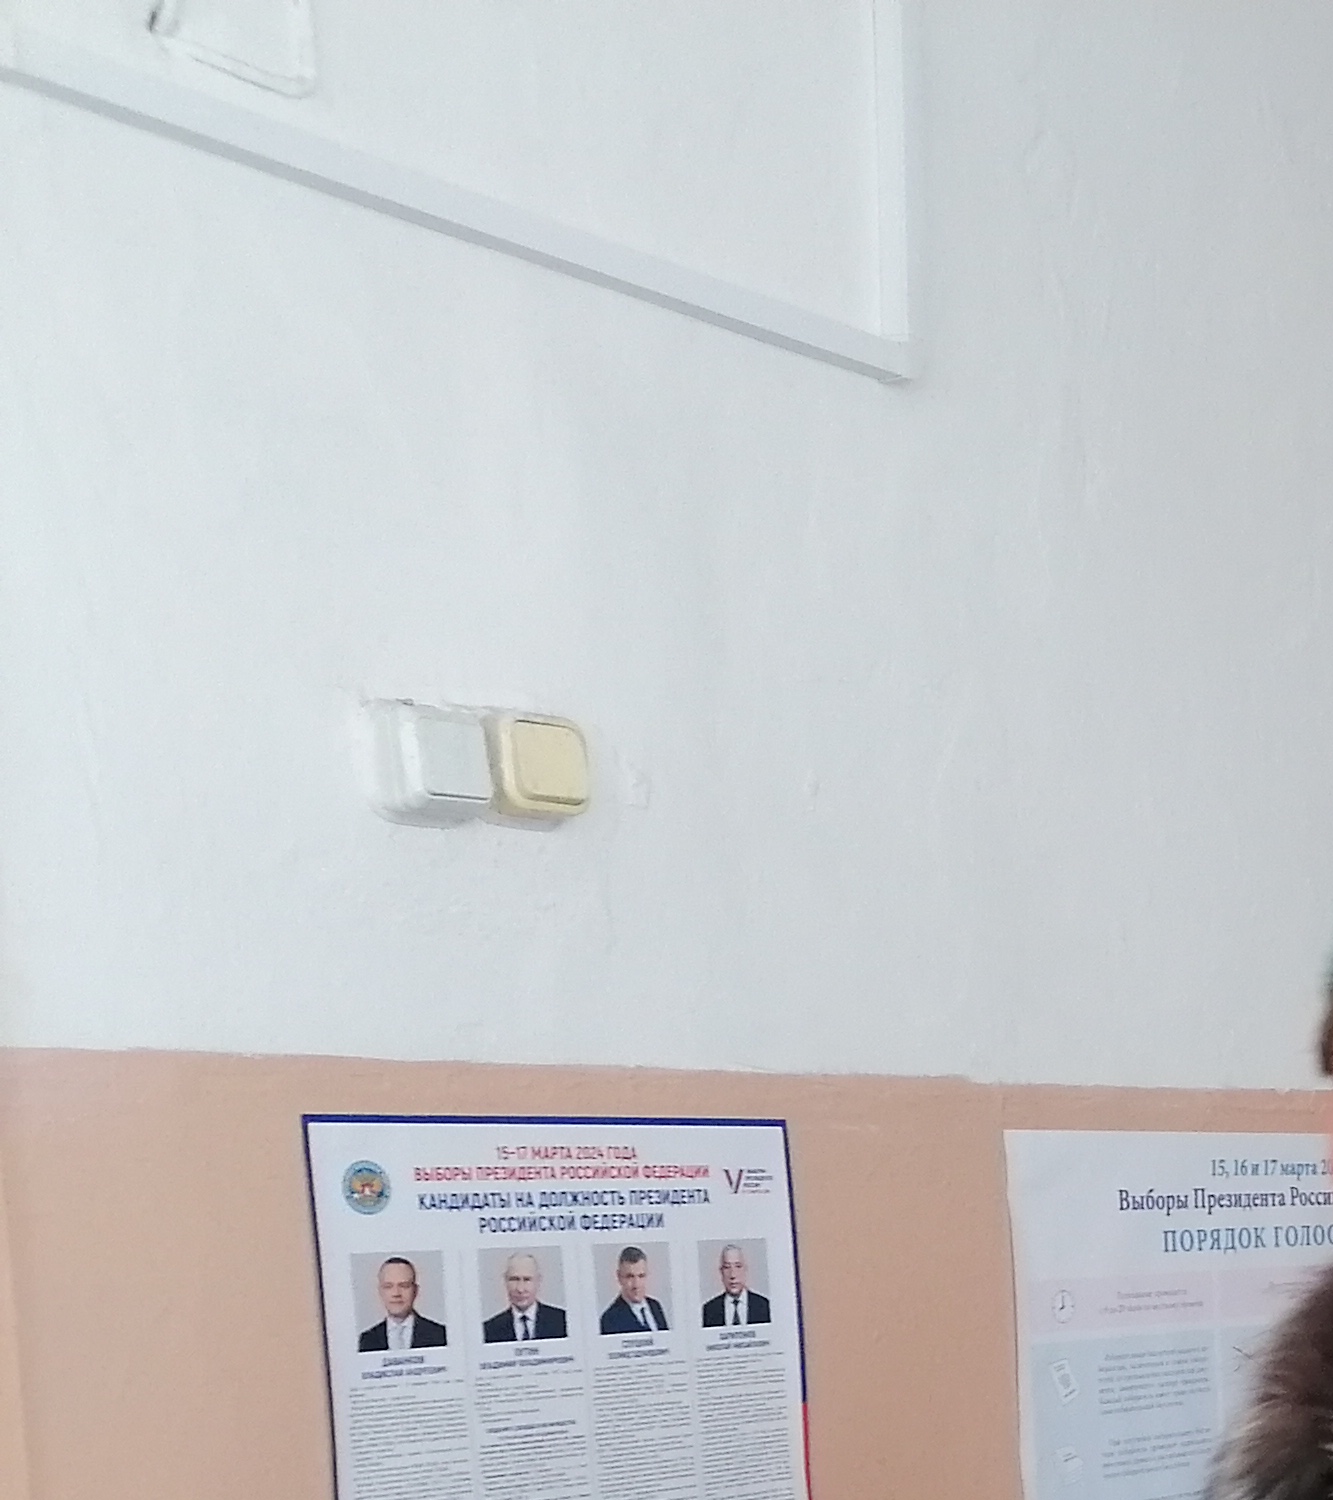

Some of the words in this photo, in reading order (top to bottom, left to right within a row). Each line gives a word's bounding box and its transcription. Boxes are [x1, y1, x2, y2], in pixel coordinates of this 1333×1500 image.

[531, 1145, 573, 1160] МАРТА
[606, 1145, 637, 1160] ГОДА
[414, 1166, 472, 1182] ВЫБОРЫ
[476, 1165, 557, 1182] ПРЕЗИДЕНТА
[560, 1161, 640, 1181] РОССИЙСКОЙ
[643, 1164, 710, 1180] ФЕДЕРАЦИИ
[1211, 1159, 1229, 1178] 15,
[1234, 1159, 1248, 1176] 16
[1250, 1163, 1260, 1176] и
[1264, 1159, 1278, 1176] 17
[1280, 1163, 1317, 1181] марта
[417, 1191, 511, 1211] КАНДИДАТЫ
[515, 1191, 535, 1208] НА
[538, 1189, 625, 1209] ДОЛЖНОСТЬ
[629, 1188, 711, 1207] ПРЕЗИДЕНТА
[1118, 1188, 1188, 1216] Выборы
[1193, 1187, 1286, 1215] Президента
[479, 1210, 577, 1233] РОССИЙСКОЙ
[580, 1212, 665, 1232] ФЕДЕРАЦИИ
[1163, 1227, 1267, 1255] ПОРЯДОК
